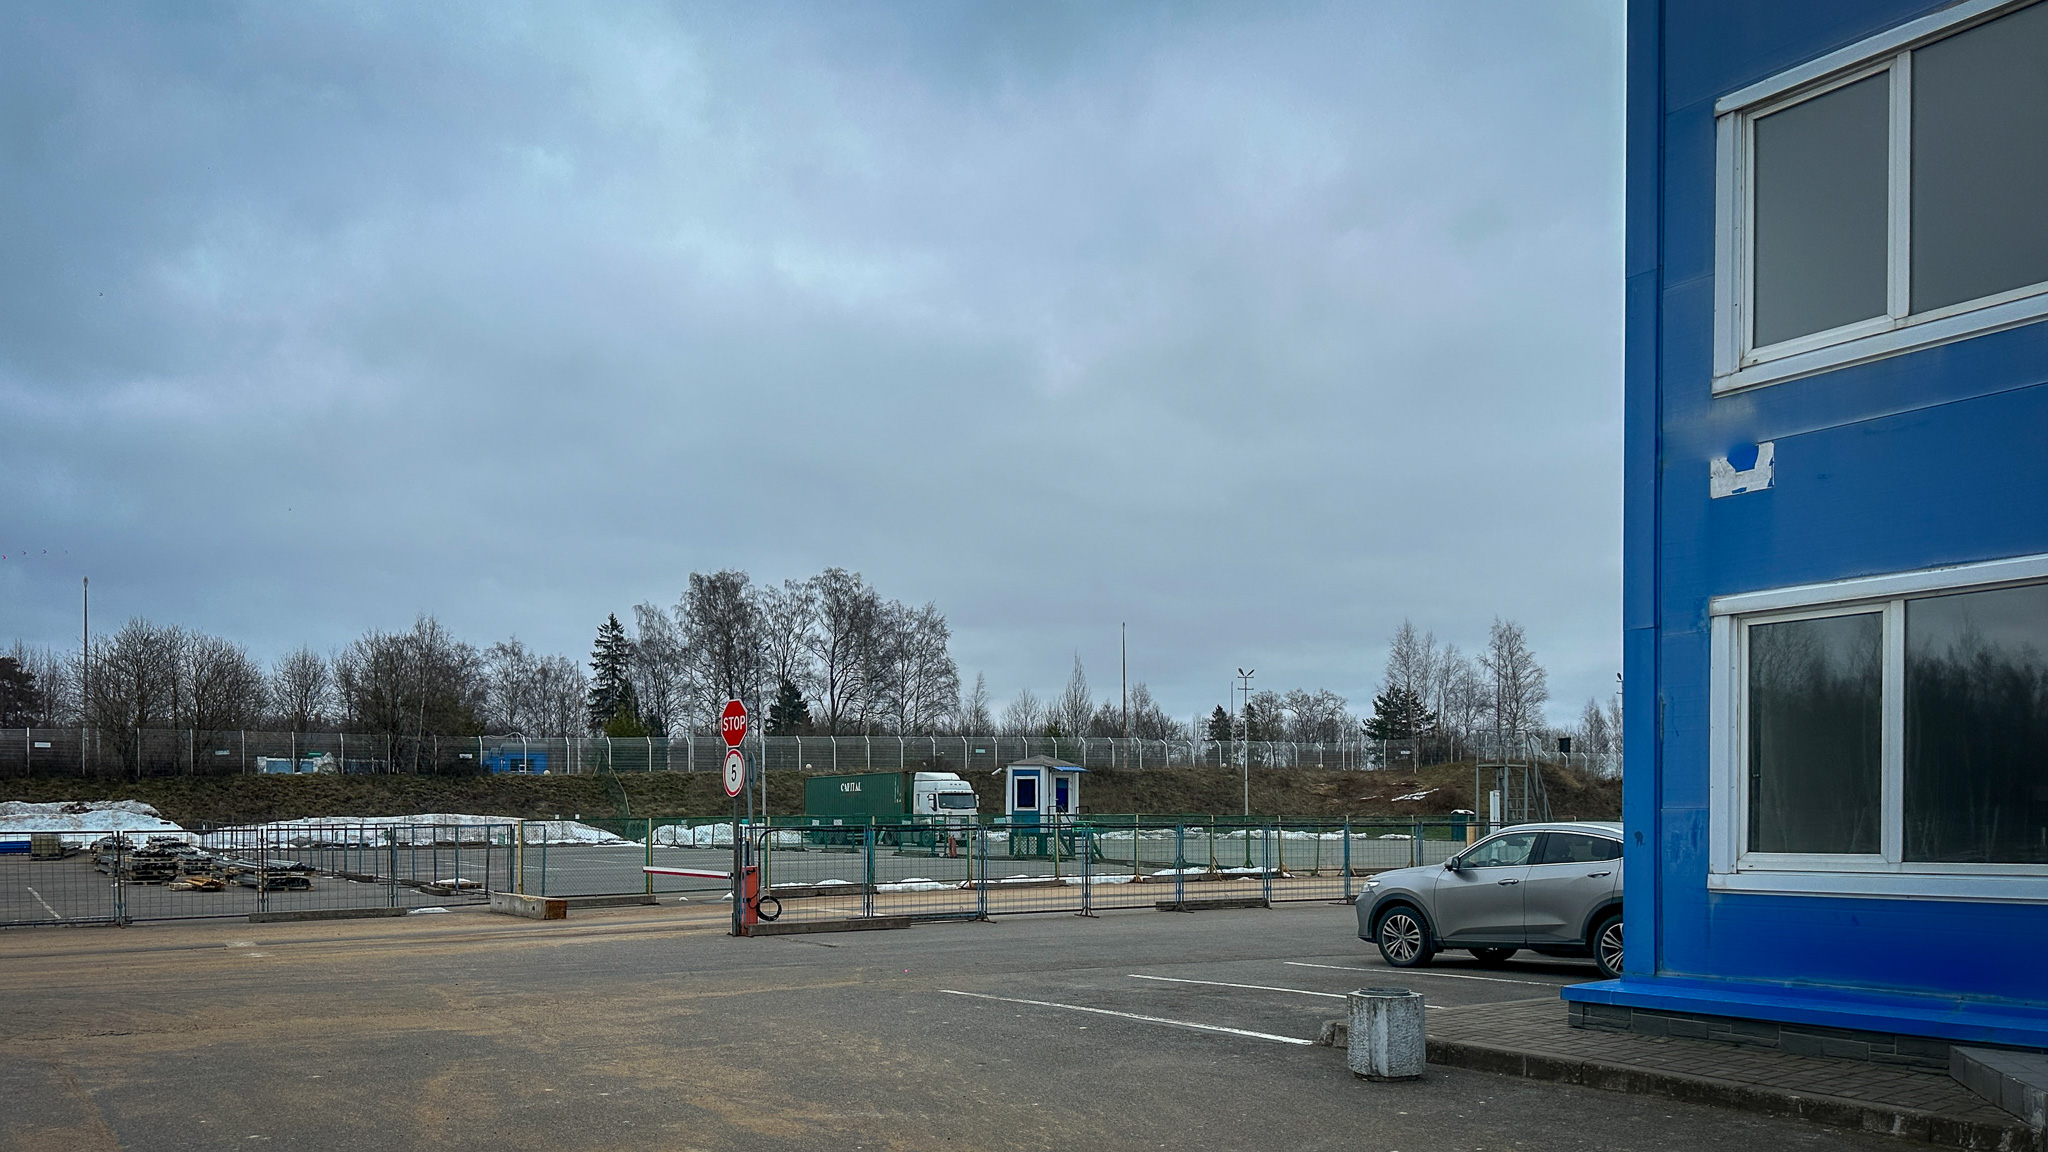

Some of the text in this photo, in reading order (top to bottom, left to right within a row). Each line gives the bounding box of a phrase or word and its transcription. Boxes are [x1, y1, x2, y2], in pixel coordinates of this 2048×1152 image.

[723, 715, 746, 732] STOP
[731, 764, 737, 782] 5
[840, 781, 862, 792] CAPITAL
